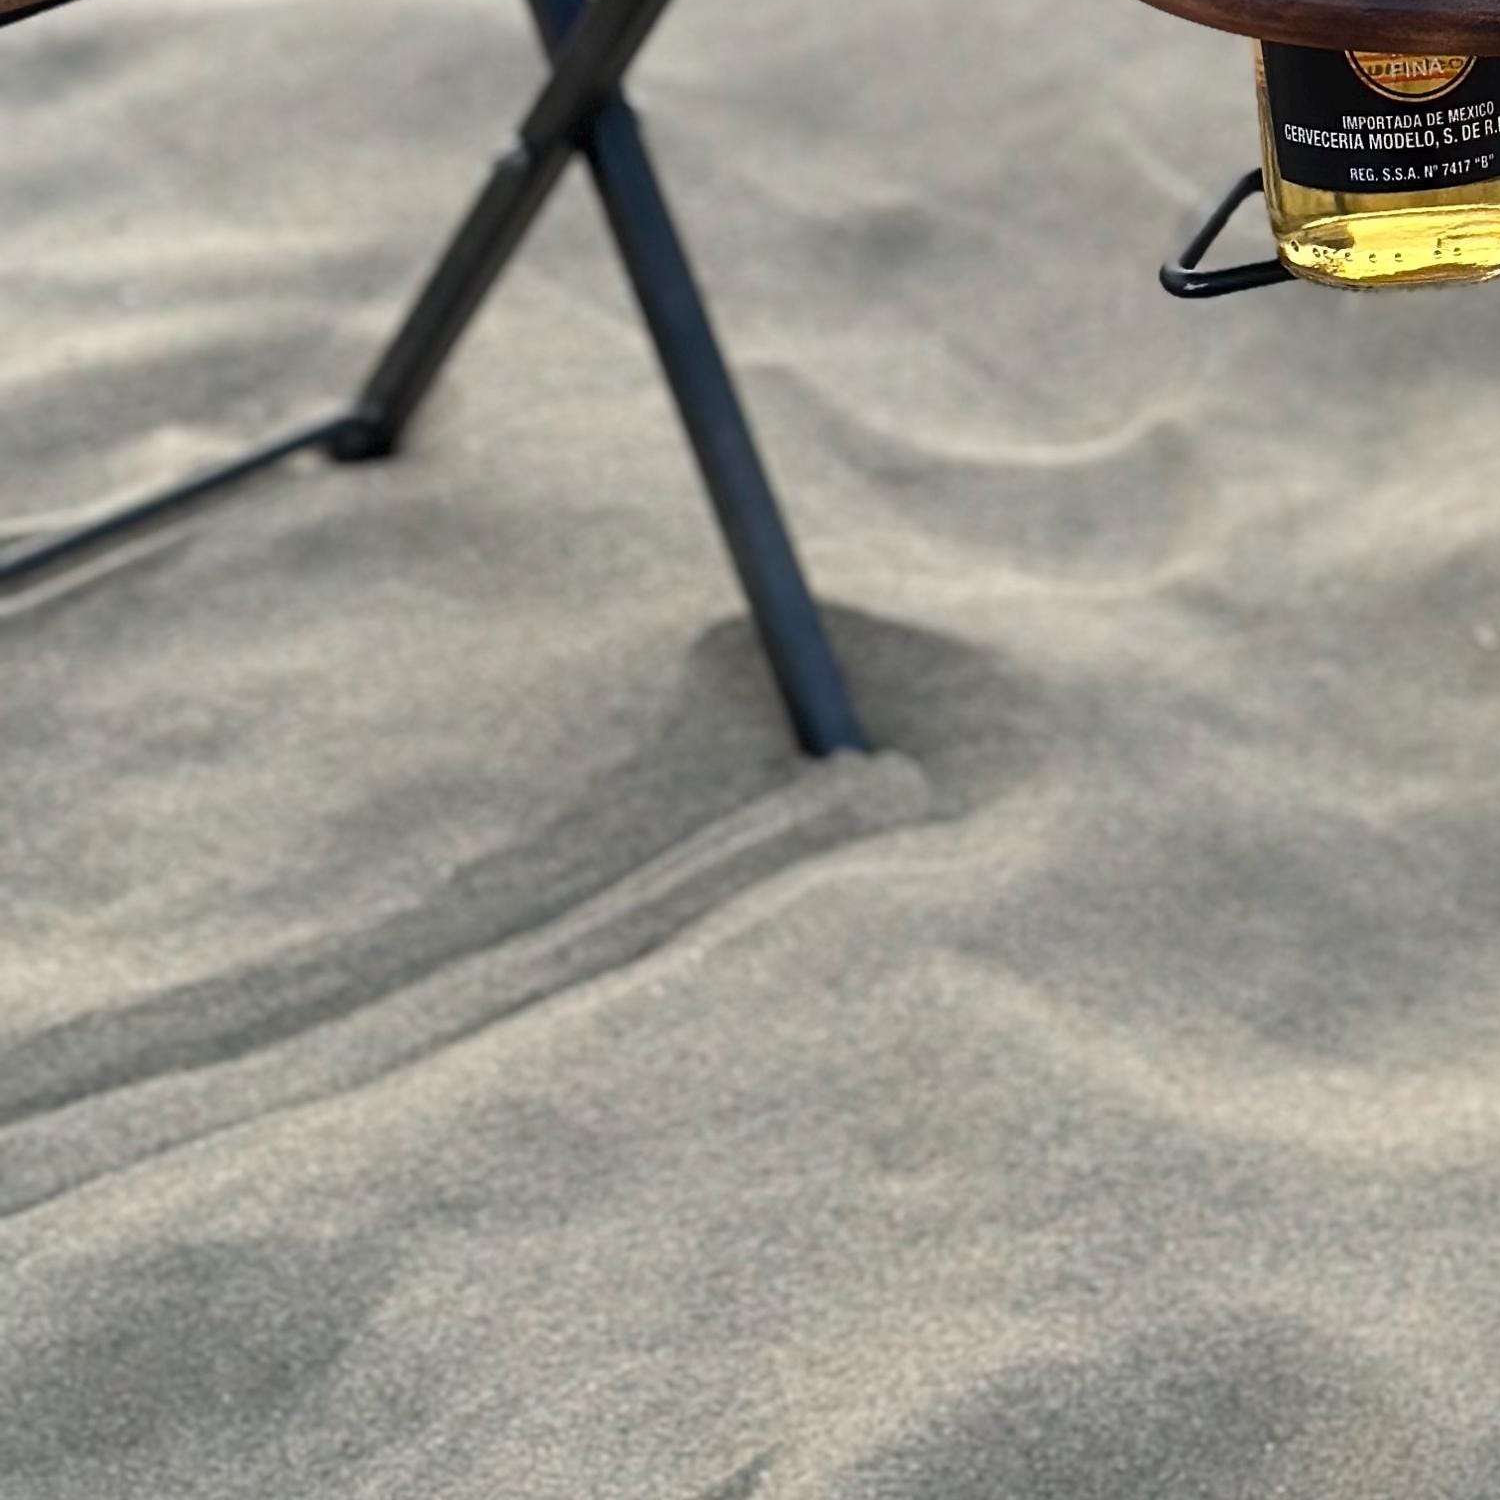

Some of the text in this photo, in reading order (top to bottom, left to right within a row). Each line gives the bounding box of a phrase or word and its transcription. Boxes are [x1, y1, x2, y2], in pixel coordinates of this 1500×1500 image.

[1342, 100, 1495, 131] IMPORTADA DE MEXICO
[1284, 123, 1365, 150] CERVECERIA
[1368, 130, 1440, 150] MODELO,
[1443, 127, 1459, 145] S.
[1462, 122, 1481, 142] DE
[1349, 167, 1379, 182] REG.
[1382, 166, 1421, 182] S.S.A.
[1442, 159, 1471, 177] 7417
